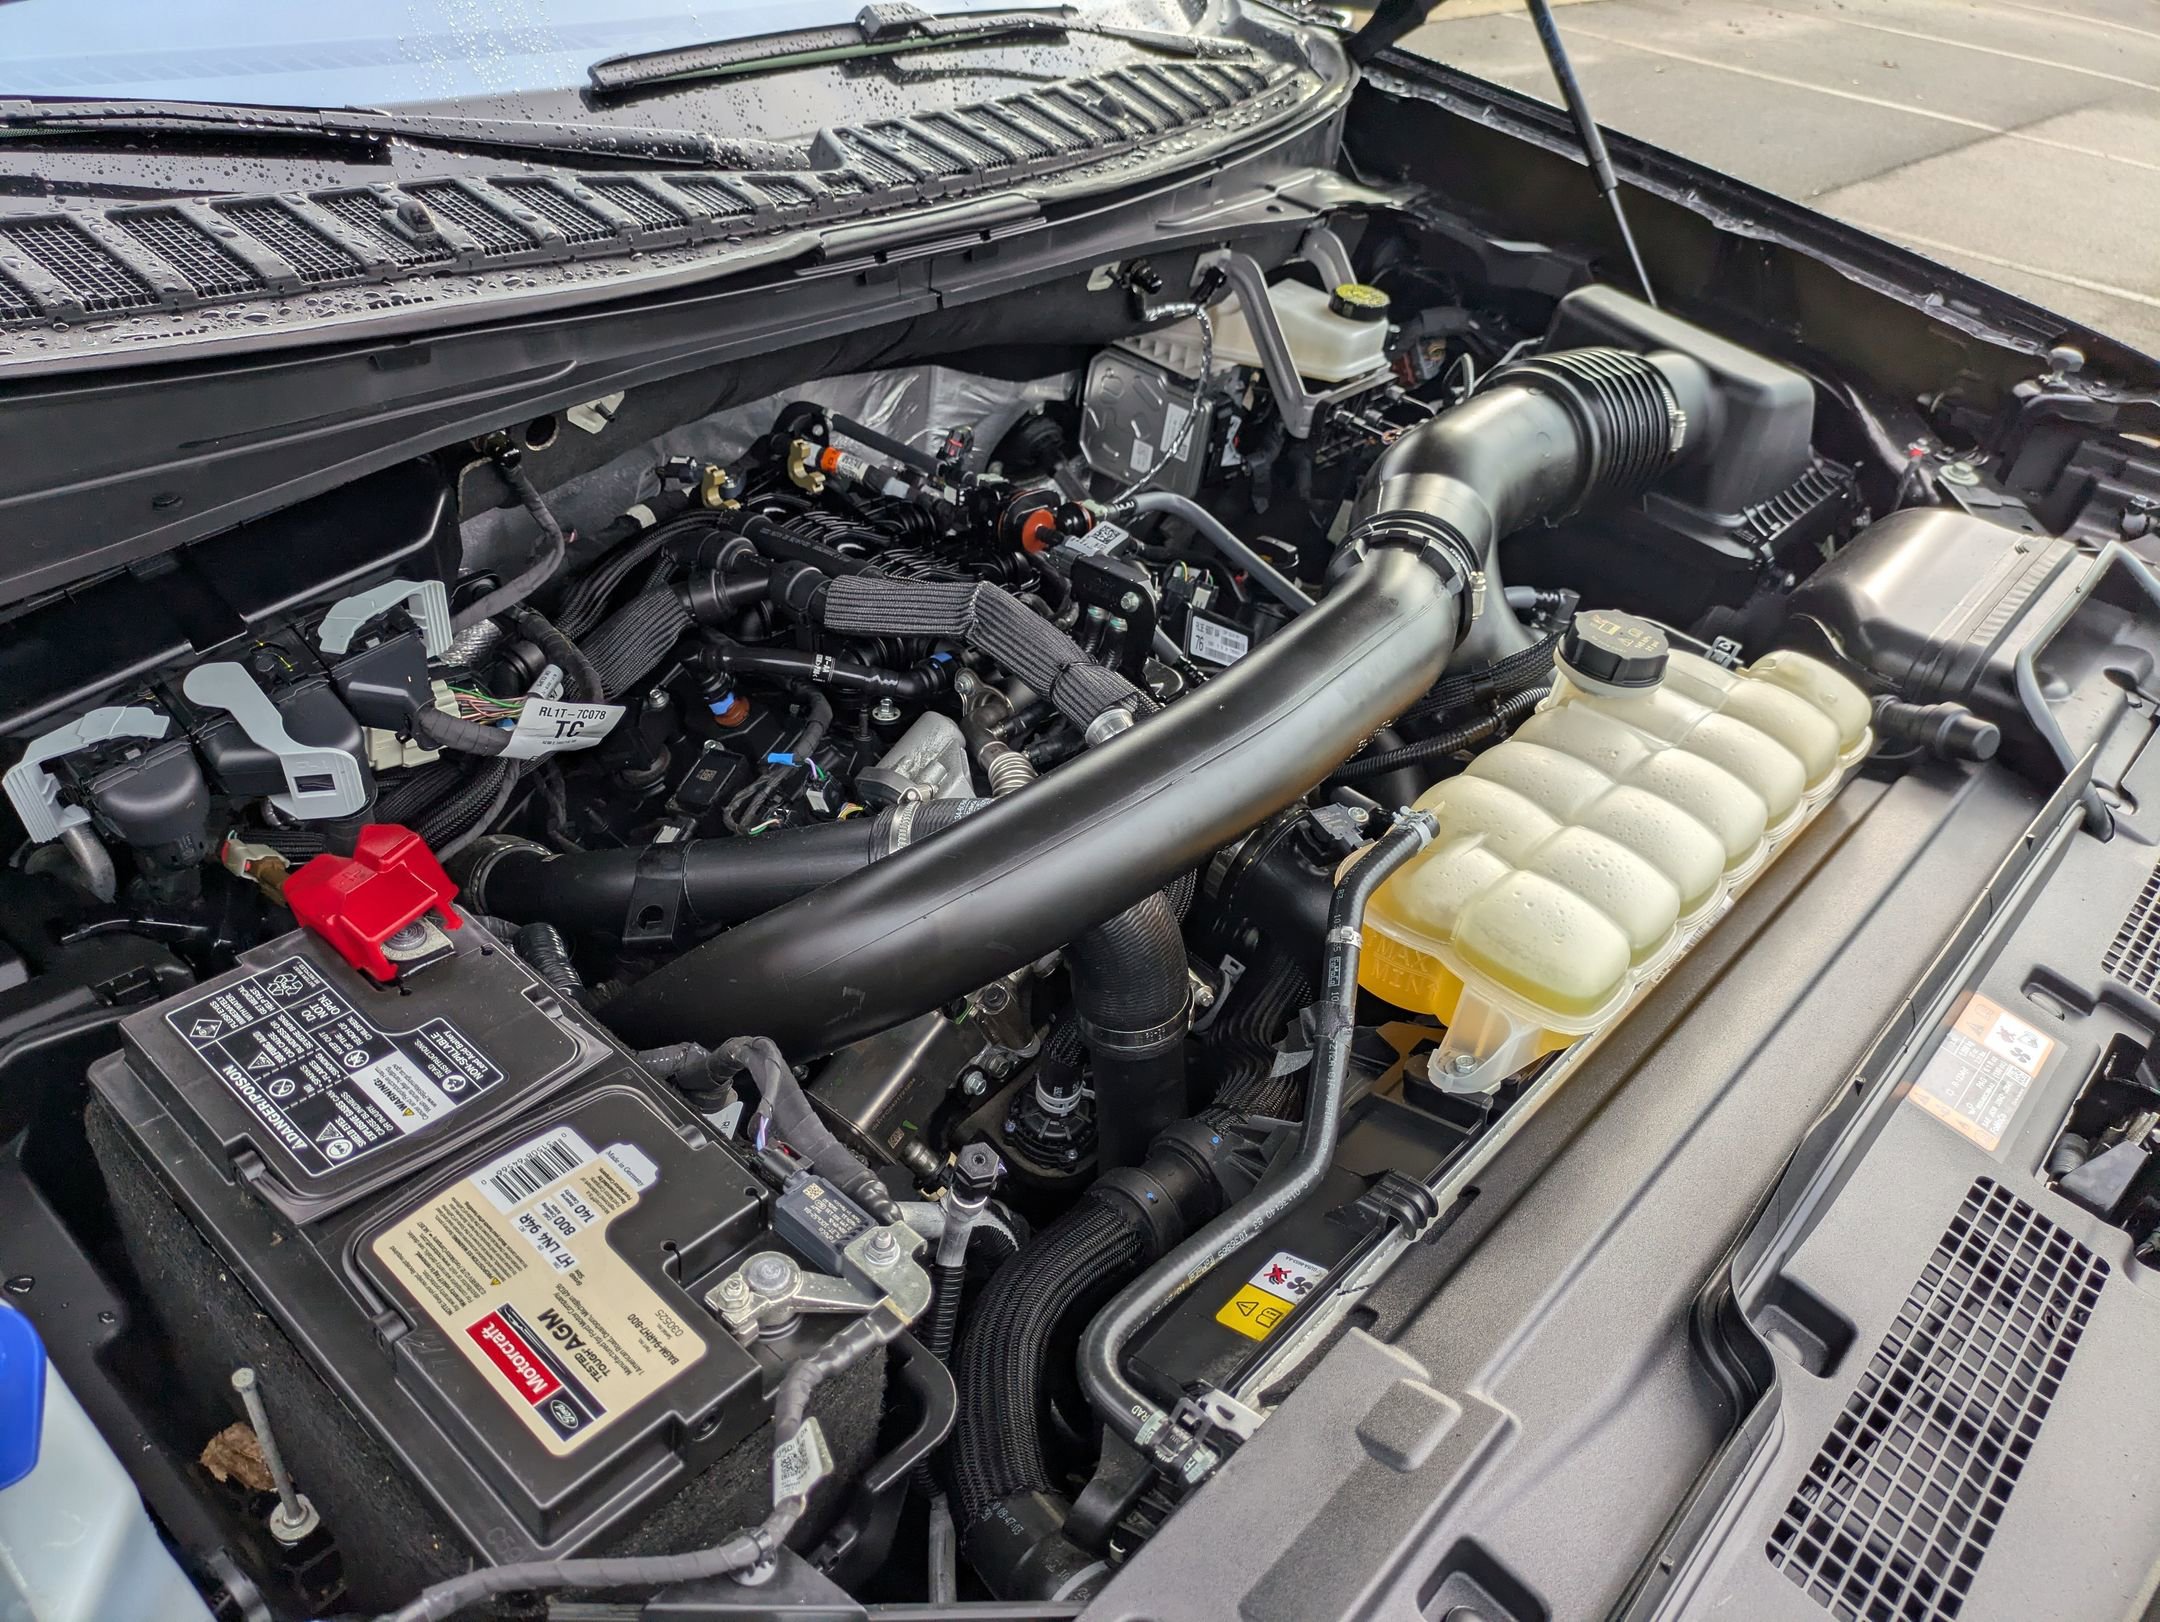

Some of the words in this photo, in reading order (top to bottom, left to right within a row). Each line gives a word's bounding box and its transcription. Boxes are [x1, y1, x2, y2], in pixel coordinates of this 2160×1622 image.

[1194, 634, 1203, 650] 76
[538, 705, 606, 722] RL1T-7C078
[555, 717, 586, 738] TC
[223, 992, 244, 1010] WATER.
[235, 984, 259, 1005] MEDICAL
[248, 985, 264, 999] FAST.
[208, 1000, 224, 1013] EYES
[215, 995, 247, 1024] IMMEDIATELY
[254, 1003, 268, 1014] GET
[259, 997, 275, 1011] HELP
[308, 1001, 329, 1018] NOT
[315, 993, 341, 1015] OPEN.
[219, 1012, 239, 1028] FLUSH
[239, 1008, 255, 1021] WITH
[275, 1013, 296, 1031] BURNS.
[300, 1009, 316, 1021] DO
[268, 1019, 281, 1029] OR
[336, 1021, 348, 1029] OF
[345, 1015, 374, 1040] CHILDREN.
[251, 1029, 267, 1043] ACID
[266, 1031, 286, 1048] CAUSE
[276, 1027, 305, 1053] BLINDNESS
[291, 1029, 314, 1049] SEVERE
[318, 1030, 332, 1042] OUT
[333, 1032, 349, 1044] THE
[343, 1027, 364, 1045] REACH
[441, 1029, 465, 1049] Battery
[261, 1041, 287, 1063] SULFURIC
[281, 1046, 296, 1058] CAN
[328, 1040, 345, 1055] KEEP
[343, 1042, 354, 1050] OF
[429, 1030, 484, 1079] NON-SPILLABLE
[459, 1047, 476, 1060] Acid
[314, 1052, 339, 1075] SMOKING
[412, 1037, 452, 1074] INSTRUCTIONS.
[307, 1059, 331, 1080] FLAMES
[426, 1063, 444, 1078] READ
[471, 1058, 488, 1072] Lead
[298, 1064, 322, 1085] SPARKS
[324, 1089, 340, 1102] CAN
[371, 1077, 408, 1110] WARNING:
[221, 1064, 300, 1142] DANGER/POISON
[334, 1100, 354, 1117] GASES
[339, 1090, 370, 1119] BLINDNESS
[364, 1103, 387, 1123] INJURY.
[348, 1114, 378, 1141] EXPLOSIVE
[365, 1117, 386, 1135] CAUSE
[382, 1122, 394, 1131] OR
[345, 1128, 367, 1147] SHIELD
[573, 1203, 596, 1223] 140
[518, 1212, 543, 1234] 94R
[552, 1215, 577, 1236] 800
[536, 1231, 561, 1253] LN4
[555, 1251, 575, 1267] H7
[552, 1290, 576, 1314] Company
[566, 1294, 590, 1317] Michigan
[570, 1311, 587, 1327] Motor
[654, 1308, 684, 1337] 030525
[535, 1306, 586, 1354] AGM
[582, 1324, 597, 1337] Ford
[592, 1334, 604, 1344] for
[477, 1321, 549, 1394] Motorcraft
[572, 1351, 604, 1382] TESTED
[598, 1341, 632, 1375] Manufactured
[617, 1349, 642, 1373] American
[1131, 1404, 1150, 1421] RAD
